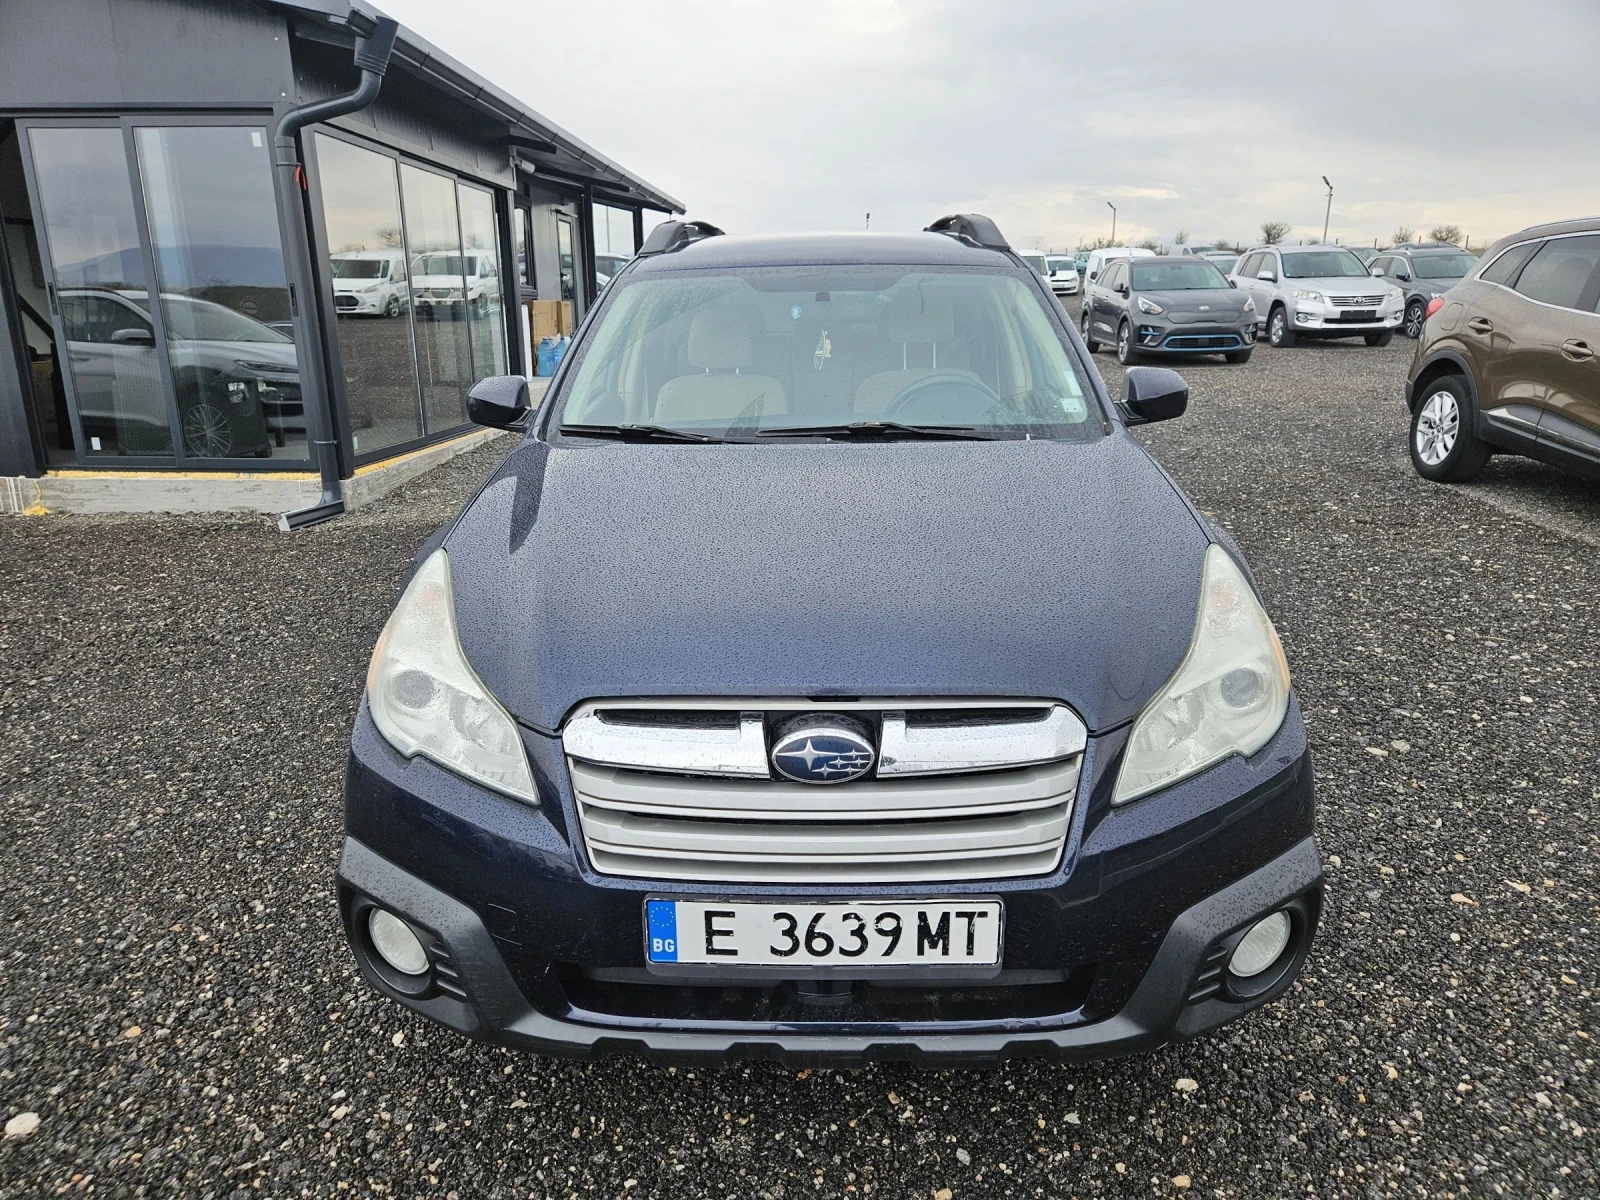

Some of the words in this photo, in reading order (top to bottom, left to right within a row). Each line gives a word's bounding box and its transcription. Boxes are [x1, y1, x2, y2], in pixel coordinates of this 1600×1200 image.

[652, 938, 675, 953] BG
[704, 910, 739, 956] E
[770, 912, 903, 958] 3639
[916, 910, 989, 957] MT
